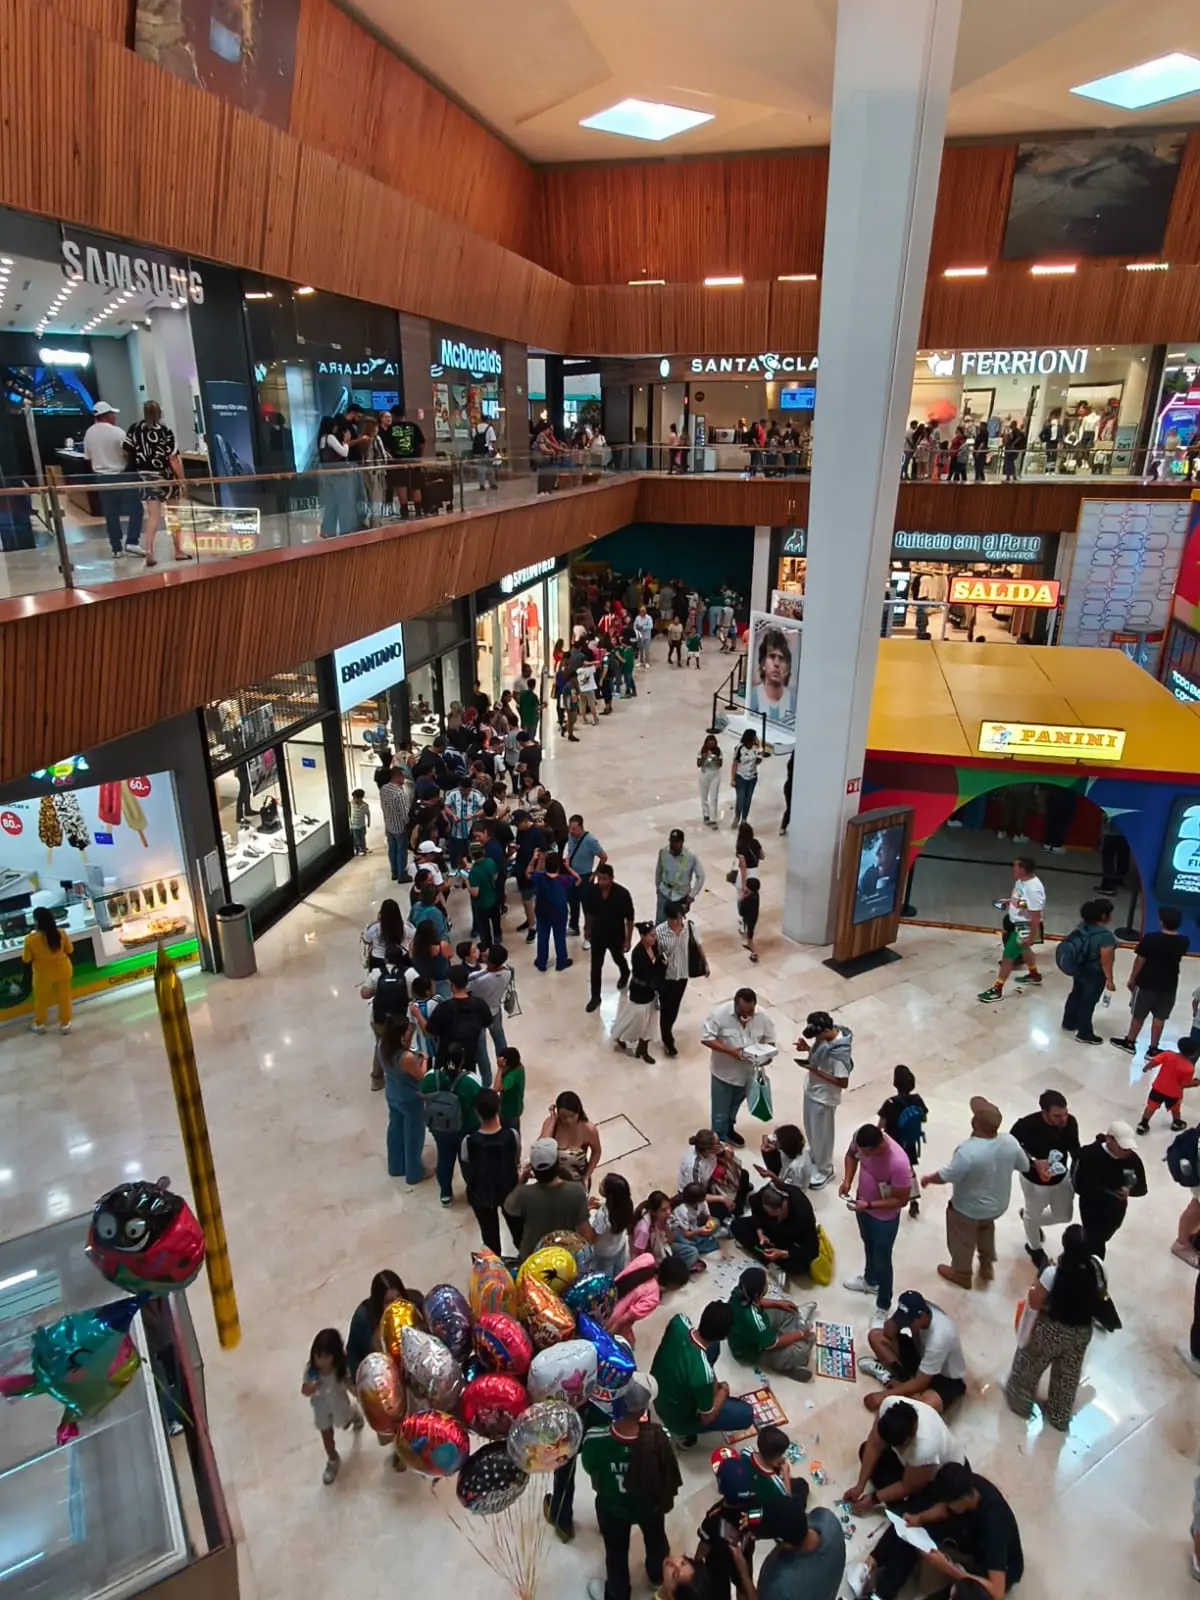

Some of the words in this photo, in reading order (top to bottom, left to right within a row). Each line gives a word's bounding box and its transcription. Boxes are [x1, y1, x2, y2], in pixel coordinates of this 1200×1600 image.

[62, 240, 204, 305] SAMSUNG
[441, 338, 502, 375] McDonald's
[691, 358, 760, 373] SANTA
[961, 348, 1089, 376] FERRIONI
[895, 531, 951, 549] Cuidado
[953, 534, 980, 552] con
[983, 534, 997, 550] el
[953, 581, 1053, 603] SALIDA
[341, 642, 402, 684] BRANTANO
[1020, 729, 1118, 748] PANINI
